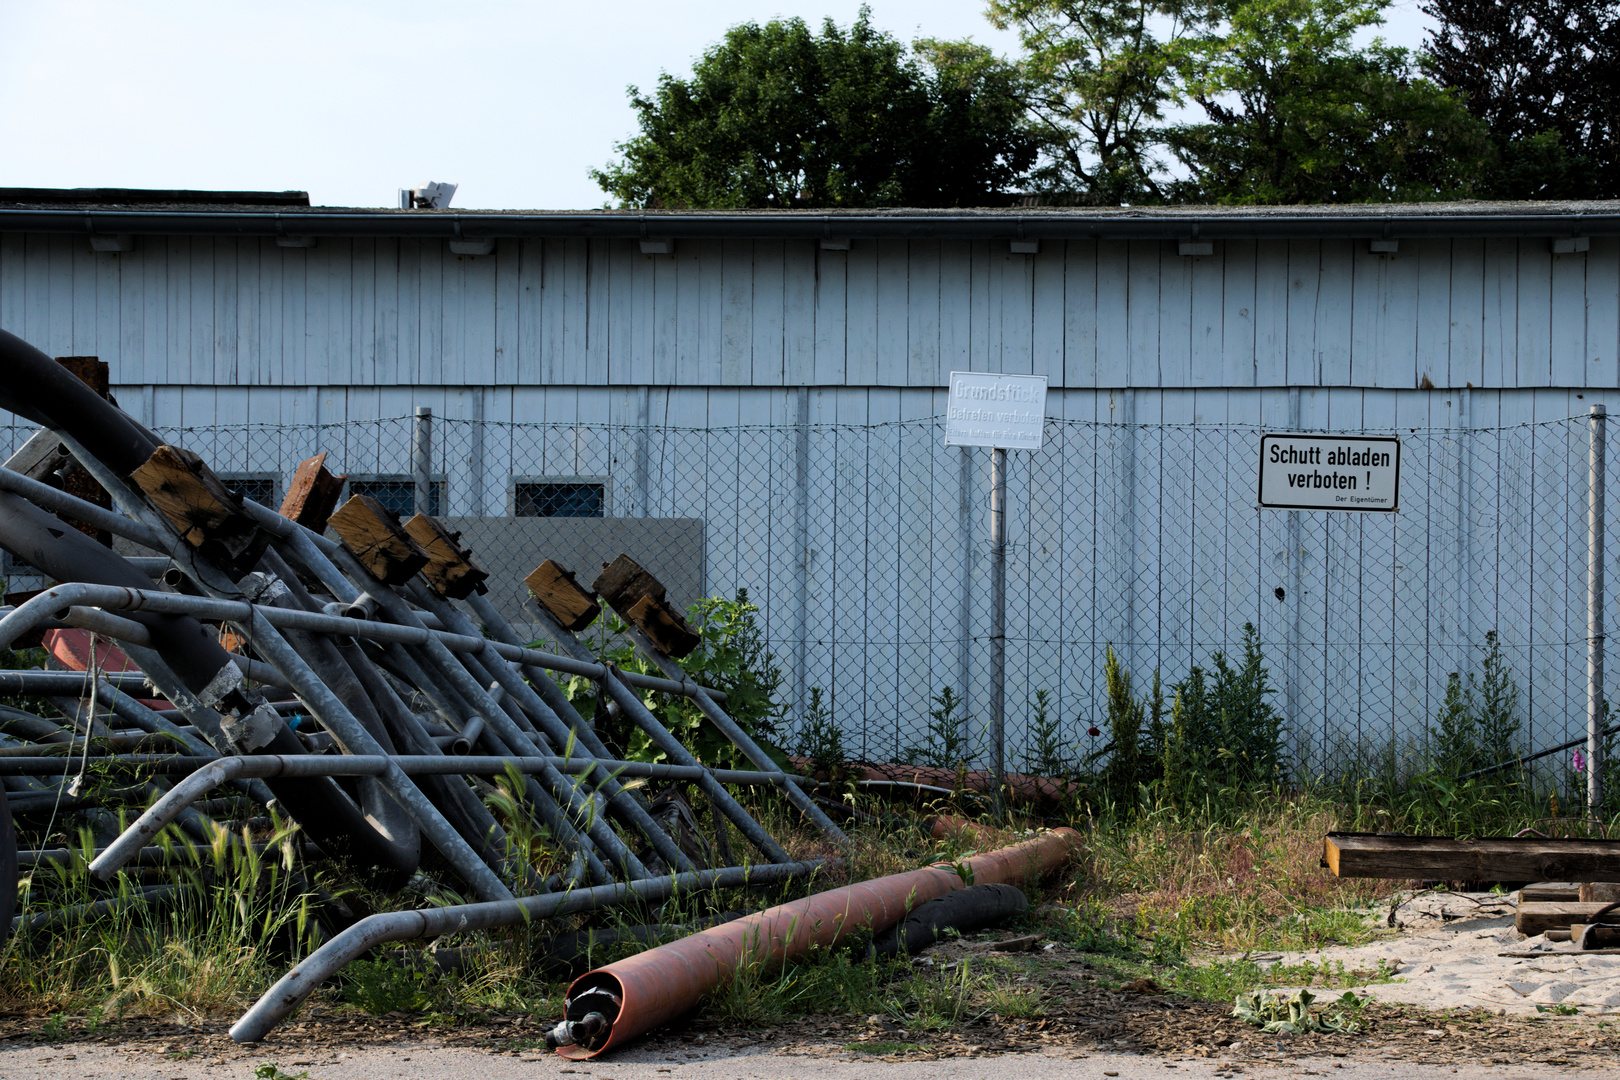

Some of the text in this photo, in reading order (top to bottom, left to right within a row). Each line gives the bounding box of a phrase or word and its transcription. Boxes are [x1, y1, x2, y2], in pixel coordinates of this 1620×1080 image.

[956, 380, 1040, 404] Grundstück
[950, 406, 1041, 425] Betreten verboten
[1270, 444, 1390, 467] Schutt abladen
[1288, 469, 1370, 490] verboten !
[1350, 496, 1388, 504] Eigentümer
